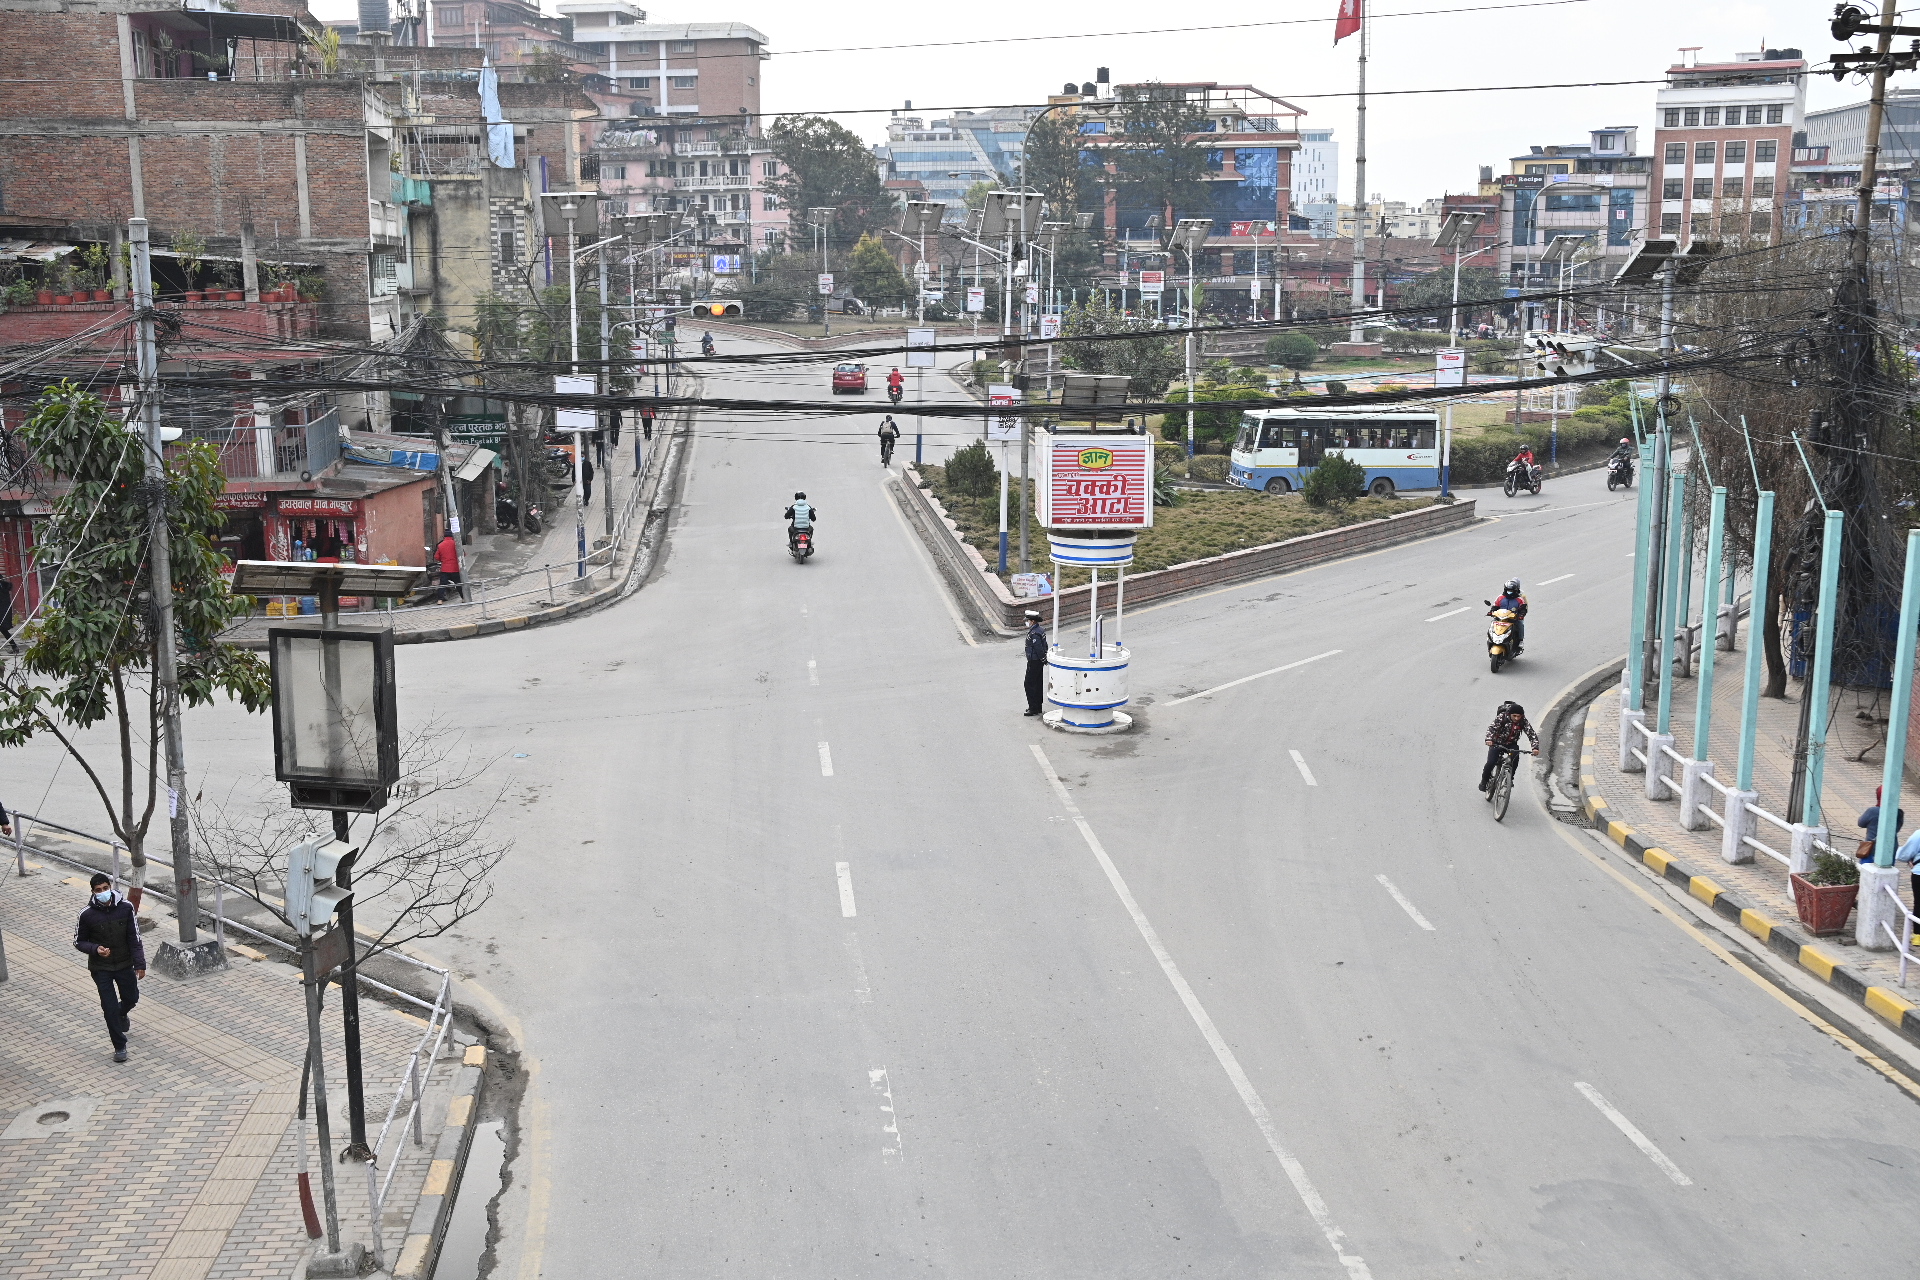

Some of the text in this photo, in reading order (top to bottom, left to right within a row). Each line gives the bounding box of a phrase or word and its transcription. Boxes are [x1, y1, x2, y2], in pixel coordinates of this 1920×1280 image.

[1066, 473, 1132, 497] चक्की
[279, 499, 312, 510] जयसवाल
[1076, 496, 1133, 516] आटा
